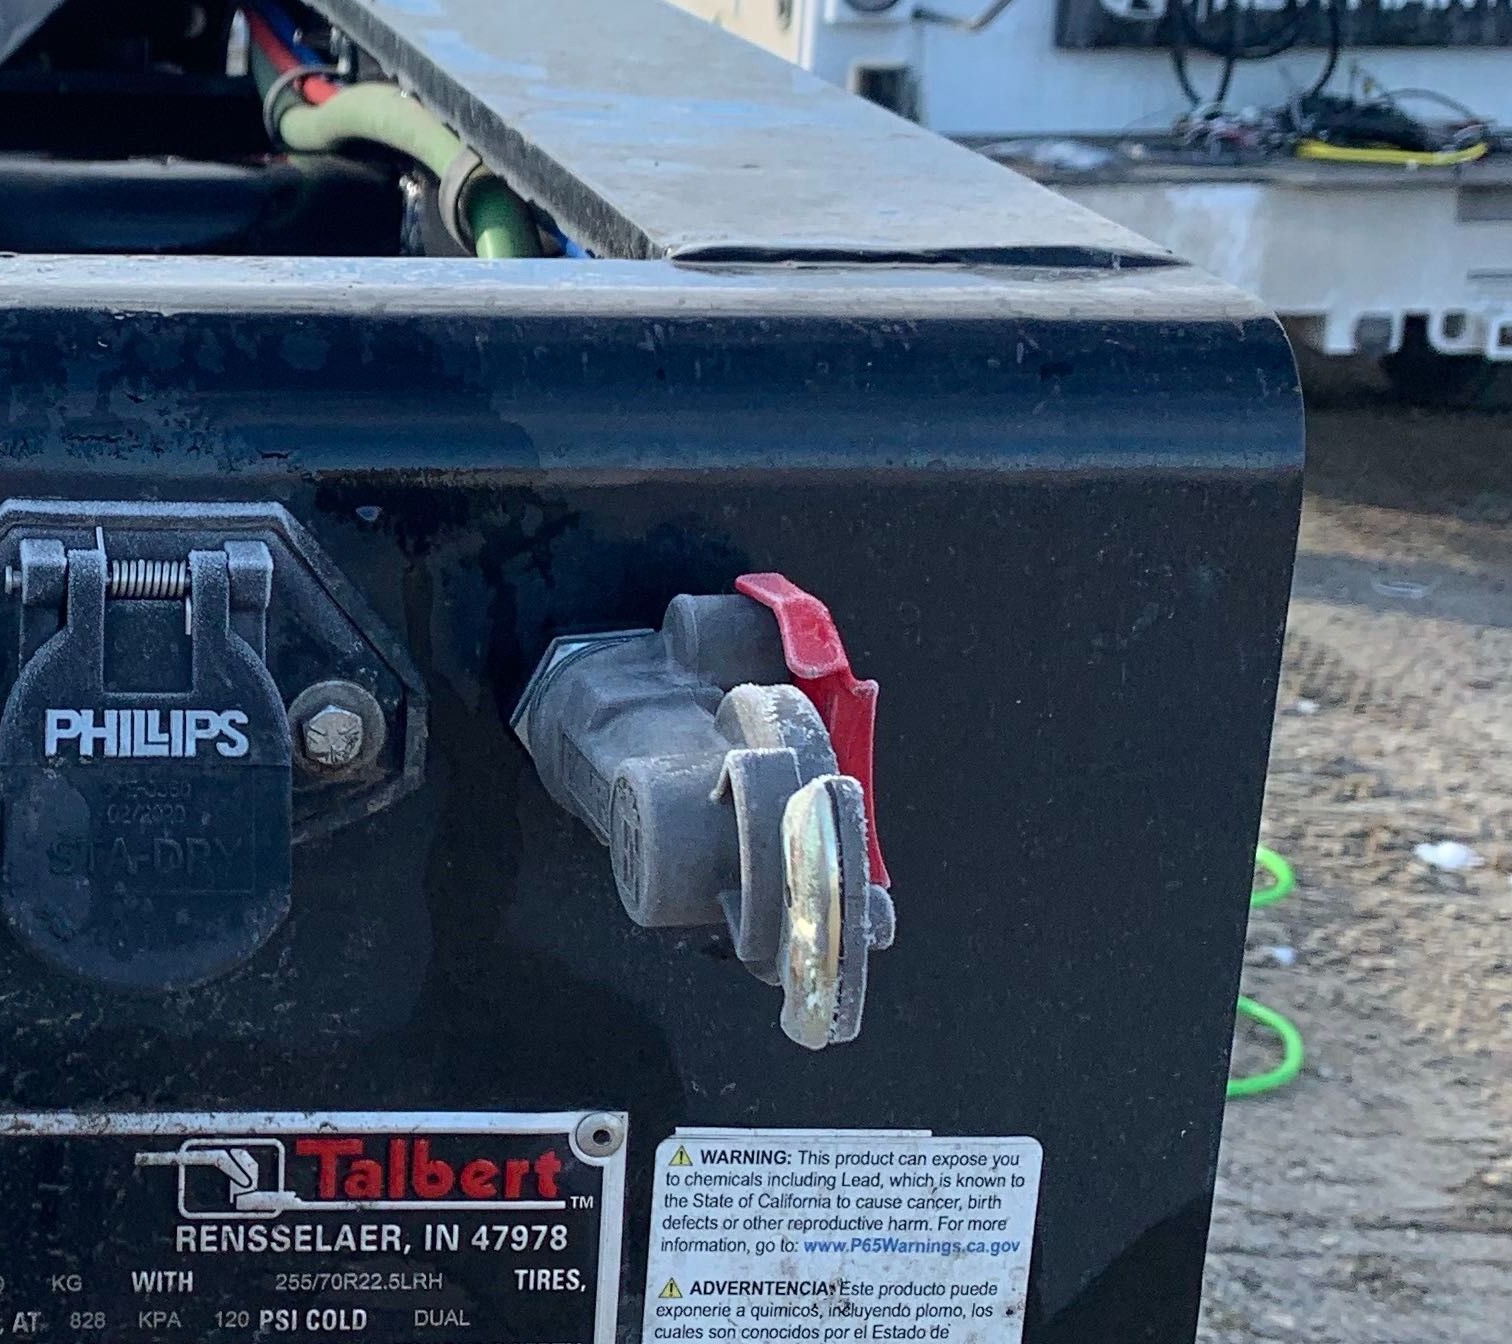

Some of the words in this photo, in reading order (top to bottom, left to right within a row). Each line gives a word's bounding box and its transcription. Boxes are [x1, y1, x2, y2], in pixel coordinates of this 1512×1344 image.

[45, 709, 249, 757] PHILLIPS
[295, 1138, 562, 1199] Talbert
[700, 1149, 792, 1166] WARNING:
[798, 1149, 831, 1167] This
[834, 1150, 894, 1169] product
[898, 1152, 927, 1167] can
[931, 1152, 987, 1169] expose
[992, 1152, 1020, 1169] you
[666, 1172, 681, 1188] to
[684, 1171, 762, 1188] chemicals
[767, 1171, 836, 1191] including
[841, 1172, 885, 1191] Lead,
[939, 1173, 951, 1188] is
[955, 1173, 1007, 1189] known
[1011, 1173, 1025, 1188] to
[663, 1193, 688, 1208] the
[692, 1193, 734, 1209] State
[737, 1193, 754, 1209] of
[757, 1193, 831, 1209] California
[836, 1194, 851, 1209] to
[855, 1197, 902, 1210] cause
[906, 1197, 963, 1212] cancer,
[967, 1194, 1002, 1210] birth
[662, 1215, 719, 1231] defects
[722, 1218, 739, 1231] or
[743, 1215, 784, 1231] other
[787, 1215, 884, 1234] reproductive
[888, 1216, 933, 1232] harm.
[937, 1216, 964, 1232] For
[967, 1219, 1008, 1232] more
[175, 1225, 410, 1254] RENSSELAER,
[424, 1225, 459, 1251] IN
[471, 1224, 568, 1250] 47978
[660, 1237, 751, 1255] information,
[755, 1241, 777, 1256] go
[780, 1238, 800, 1253] to:
[804, 1238, 1020, 1255] www.P65Warnings.ca.gov
[51, 1274, 83, 1293] KG
[131, 1270, 193, 1293] WITH
[275, 1273, 443, 1291] 255/70R22.5LRH
[514, 1268, 586, 1293] TIRES,
[839, 1281, 874, 1297] Este
[878, 1281, 946, 1299] producto
[950, 1282, 998, 1299] puede
[12, 1311, 40, 1333] AT
[70, 1312, 106, 1330] 828
[138, 1311, 182, 1329] KPA
[215, 1310, 250, 1328] 120
[259, 1309, 298, 1331] PSI
[306, 1308, 368, 1331] COLD
[413, 1309, 471, 1328] DUAL
[736, 1306, 746, 1319] a
[828, 1302, 910, 1322] incluyendo
[915, 1302, 967, 1322] plomo,
[971, 1302, 993, 1319] los
[654, 1324, 704, 1340] cuales
[708, 1327, 737, 1340] son
[741, 1325, 821, 1341] conocidos
[824, 1328, 851, 1344] por
[854, 1325, 868, 1341] el
[872, 1325, 927, 1341] Estado
[930, 1325, 950, 1341] de
